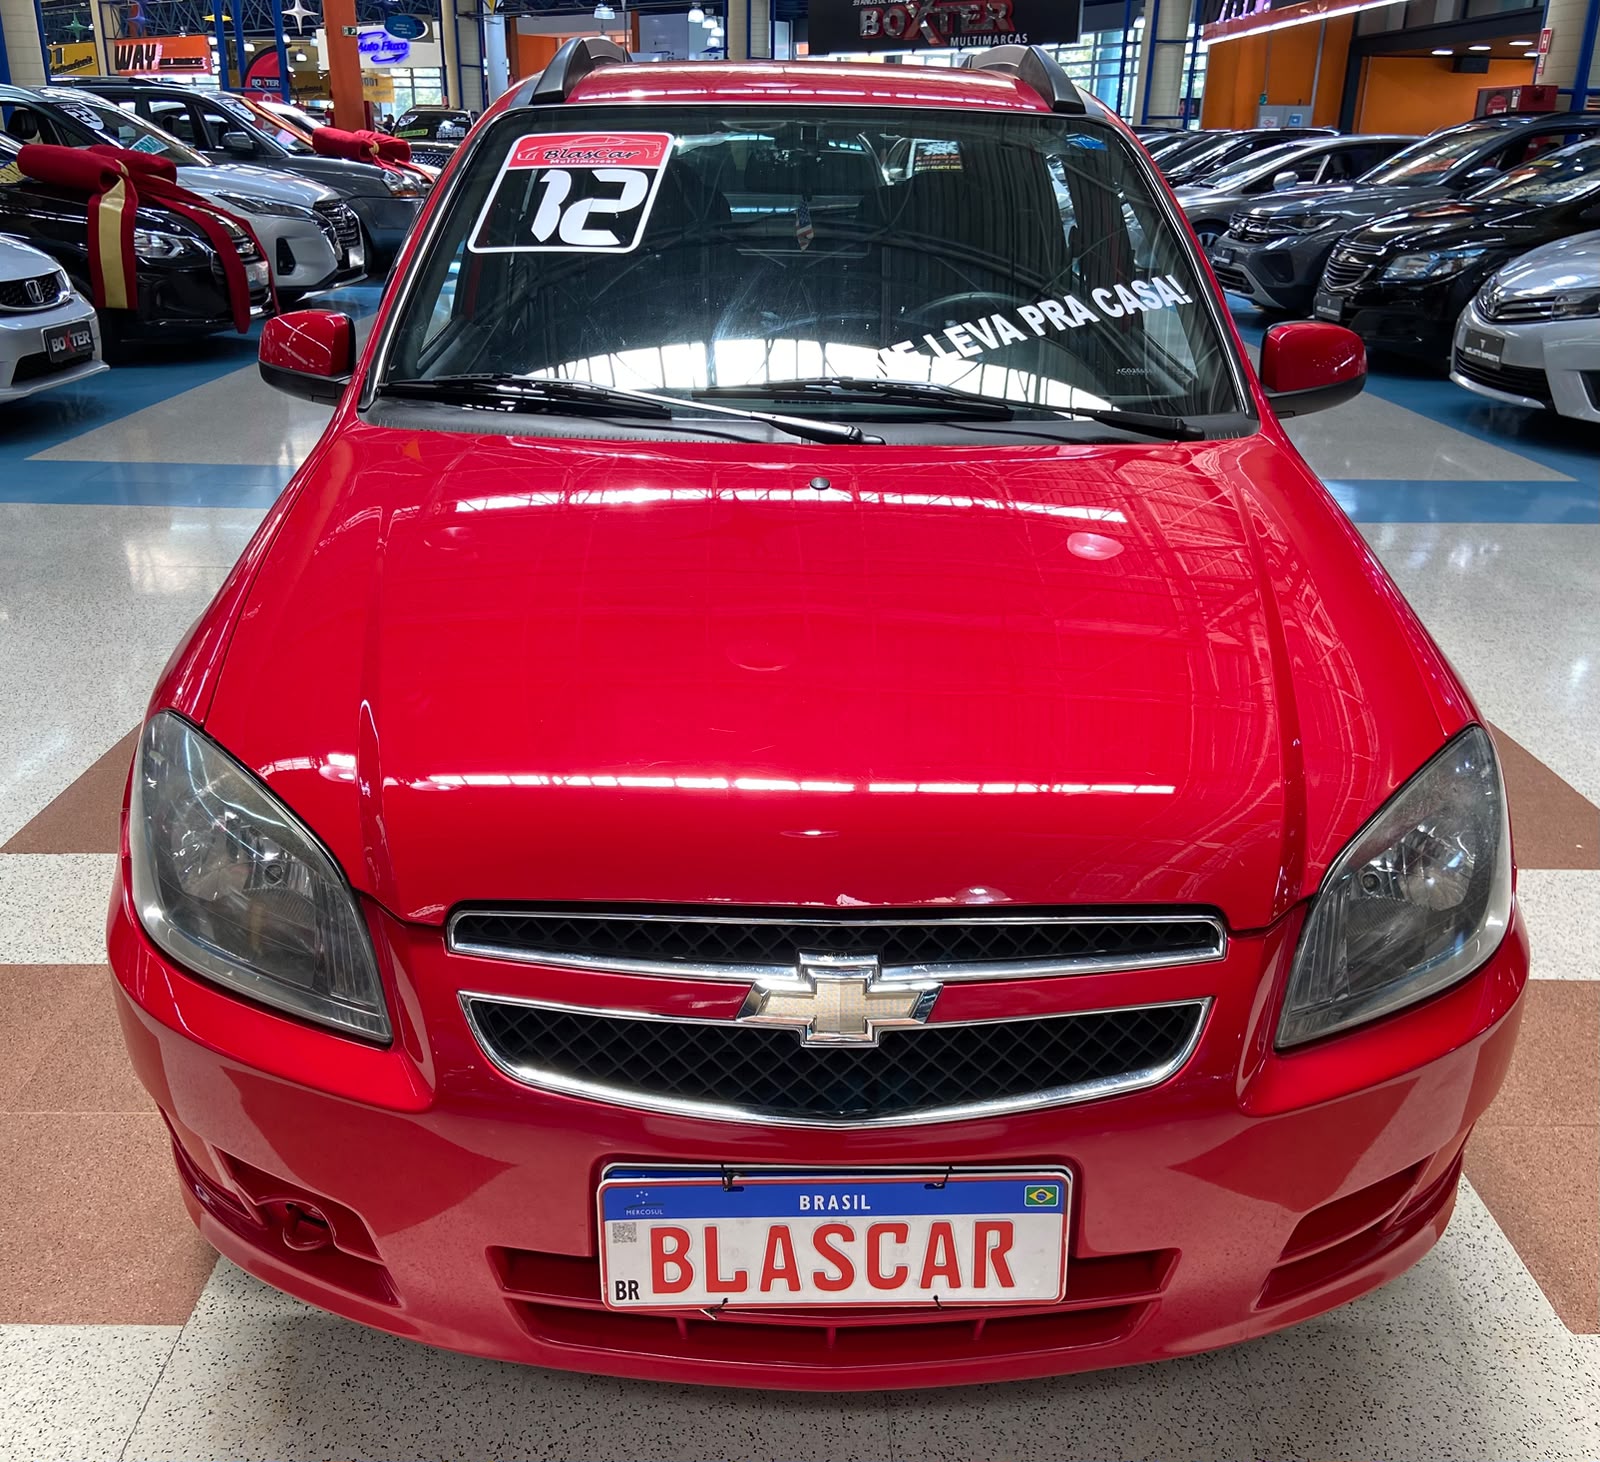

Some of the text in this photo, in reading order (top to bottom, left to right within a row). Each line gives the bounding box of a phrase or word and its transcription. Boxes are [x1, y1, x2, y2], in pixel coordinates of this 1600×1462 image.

[858, 0, 1016, 46] BOXTER
[950, 33, 1028, 47] MULTIMARCAS
[115, 43, 161, 71] WAY
[543, 148, 640, 160] BlasCar
[530, 169, 649, 246] 12
[922, 313, 1027, 365] LEVA
[1017, 294, 1100, 337] PRA
[1091, 274, 1193, 319] CASA!
[51, 328, 92, 353] BOXTER
[799, 1194, 871, 1211] BRASIL
[650, 1221, 1016, 1294] BLASCAR
[615, 1279, 640, 1301] BR
